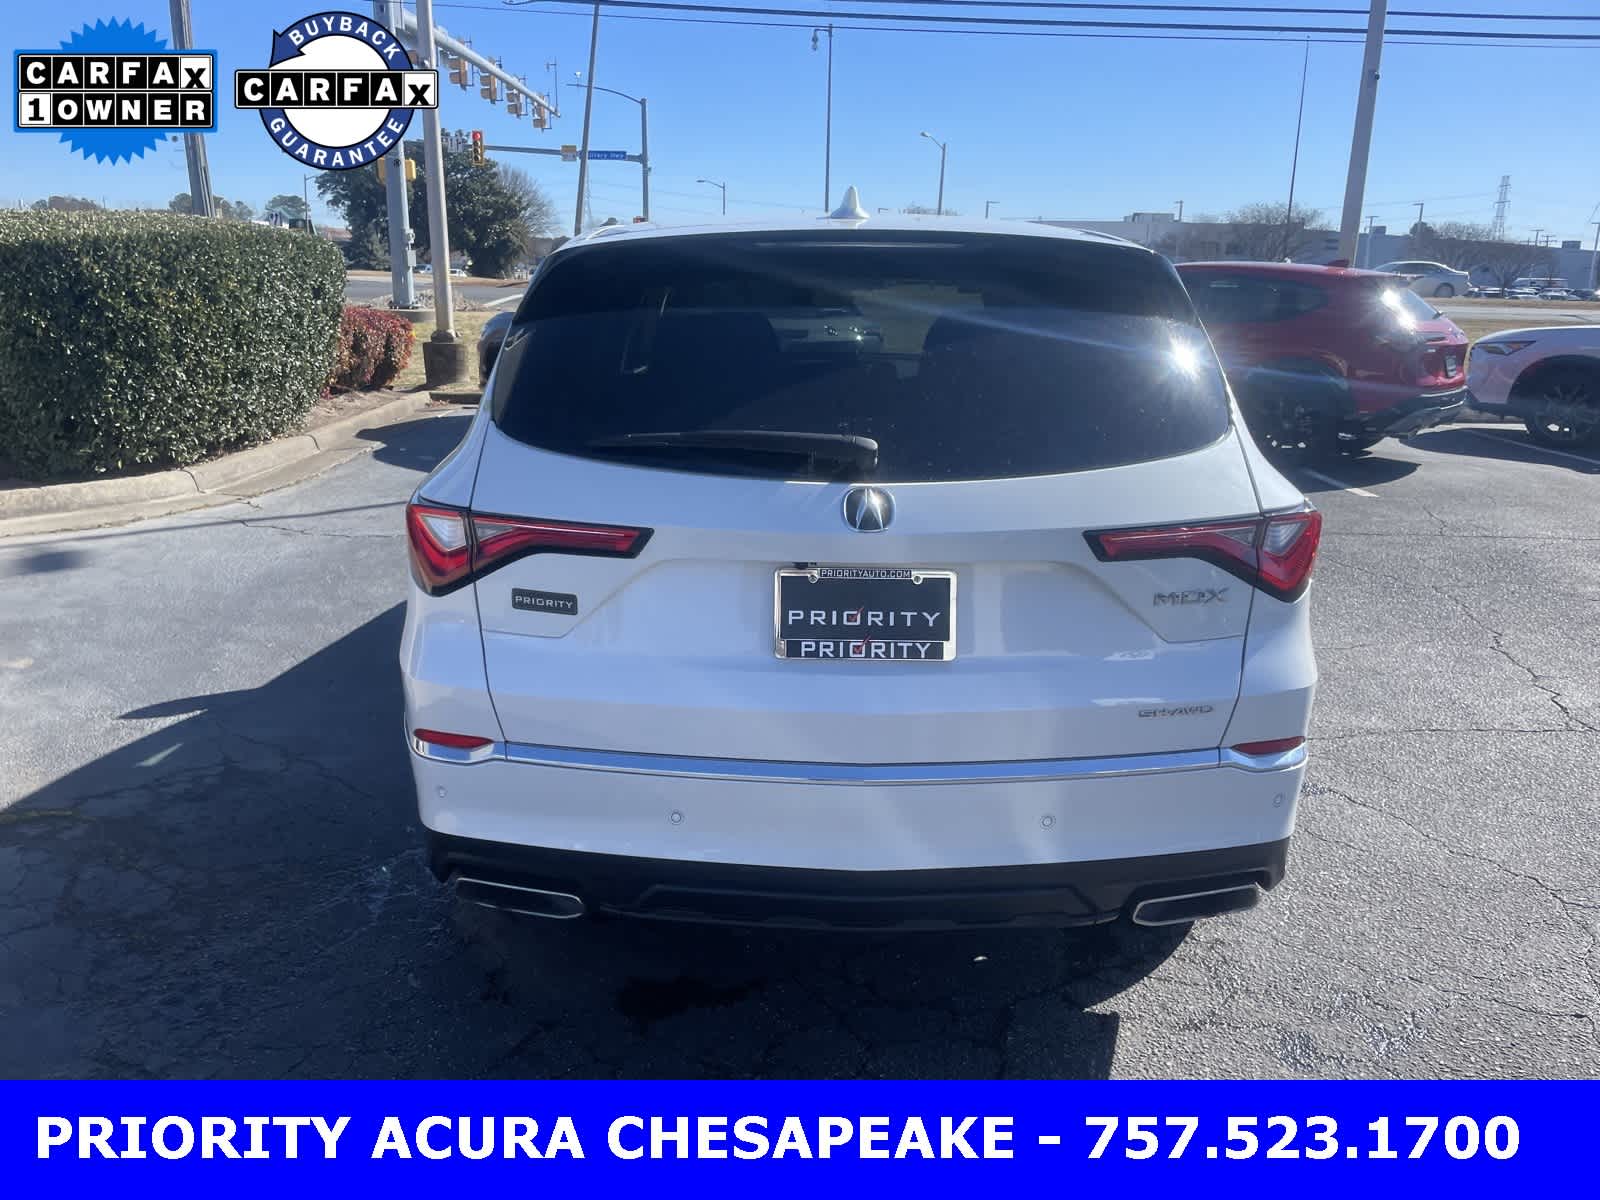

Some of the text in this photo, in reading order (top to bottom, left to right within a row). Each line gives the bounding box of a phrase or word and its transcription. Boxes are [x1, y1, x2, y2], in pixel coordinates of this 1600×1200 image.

[821, 569, 912, 578] PRIORITYAUTO.COM
[514, 595, 573, 609] PRIORITY
[1153, 588, 1230, 606] MDX
[788, 609, 941, 627] PRIORITY
[801, 641, 931, 659] PRIORITY
